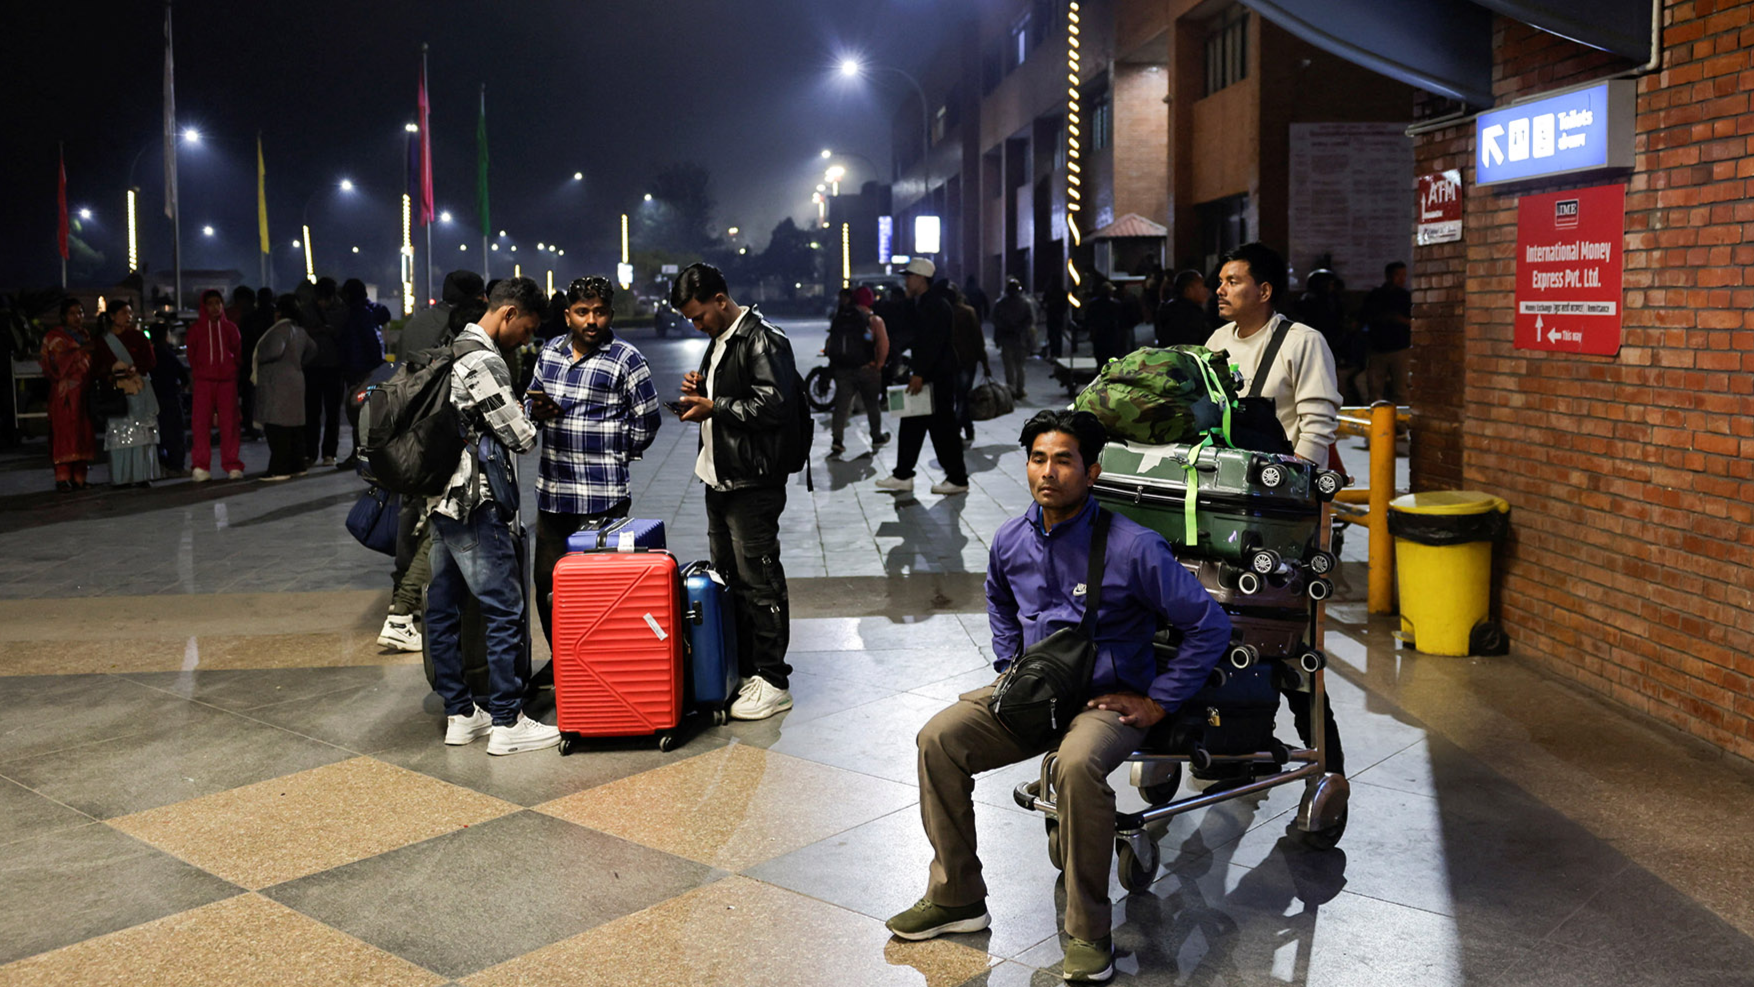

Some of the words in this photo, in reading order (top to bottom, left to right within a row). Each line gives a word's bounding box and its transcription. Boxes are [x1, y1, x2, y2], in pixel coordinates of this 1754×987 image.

[1558, 109, 1593, 131] Toilets
[1428, 180, 1456, 206] ATM
[1560, 204, 1577, 216] IME
[1526, 241, 1579, 263] International
[1581, 241, 1611, 262] Money
[1533, 270, 1564, 291] Express
[1565, 269, 1582, 288] Pvt.
[1584, 267, 1601, 288] Ltd.
